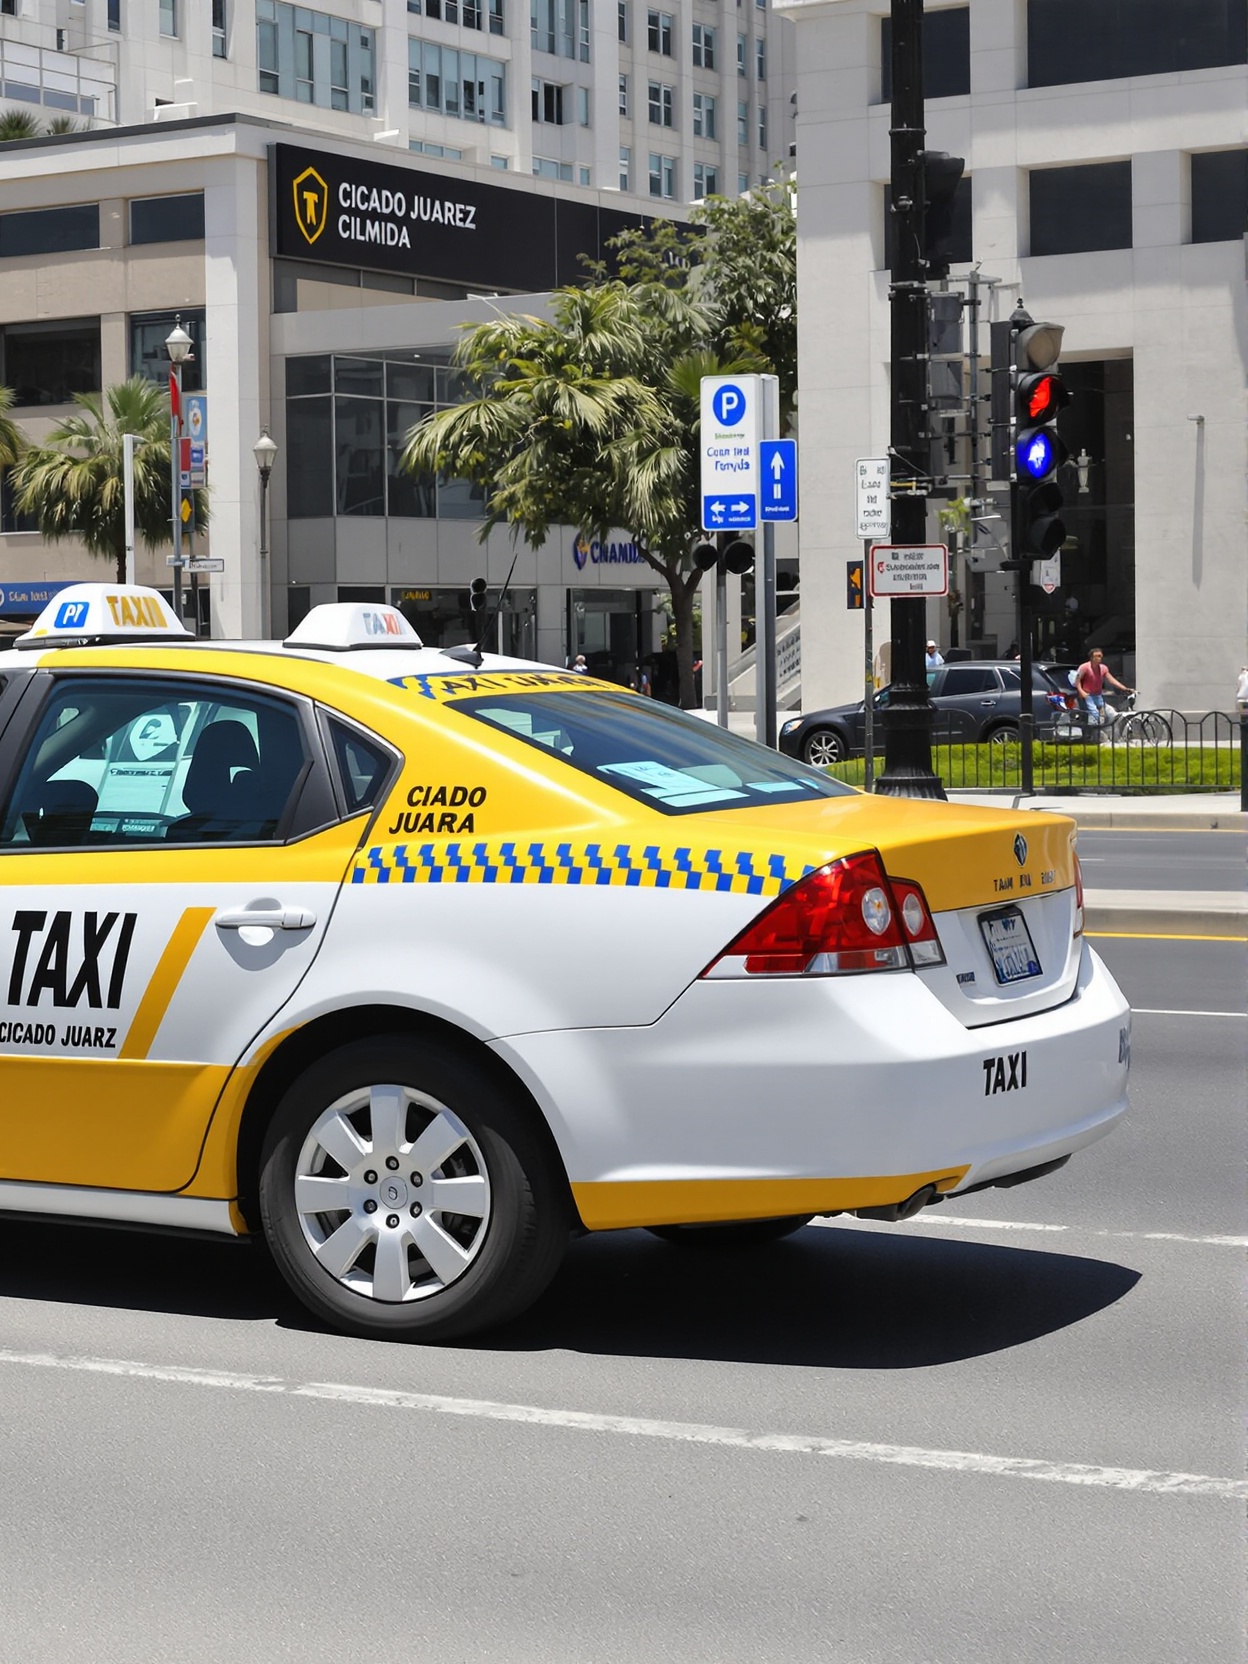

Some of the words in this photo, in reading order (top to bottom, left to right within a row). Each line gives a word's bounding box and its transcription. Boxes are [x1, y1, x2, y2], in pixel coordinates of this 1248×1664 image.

[339, 182, 406, 217] CICADO
[410, 195, 477, 230] JUAREZ
[338, 214, 411, 249] CILMIDA
[721, 391, 739, 420] P
[406, 785, 487, 807] CIADO
[388, 812, 475, 835] JUARA
[7, 910, 138, 1009] TAXI
[60, 1025, 118, 1049] JUARZ
[982, 1051, 1027, 1096] TAXI
